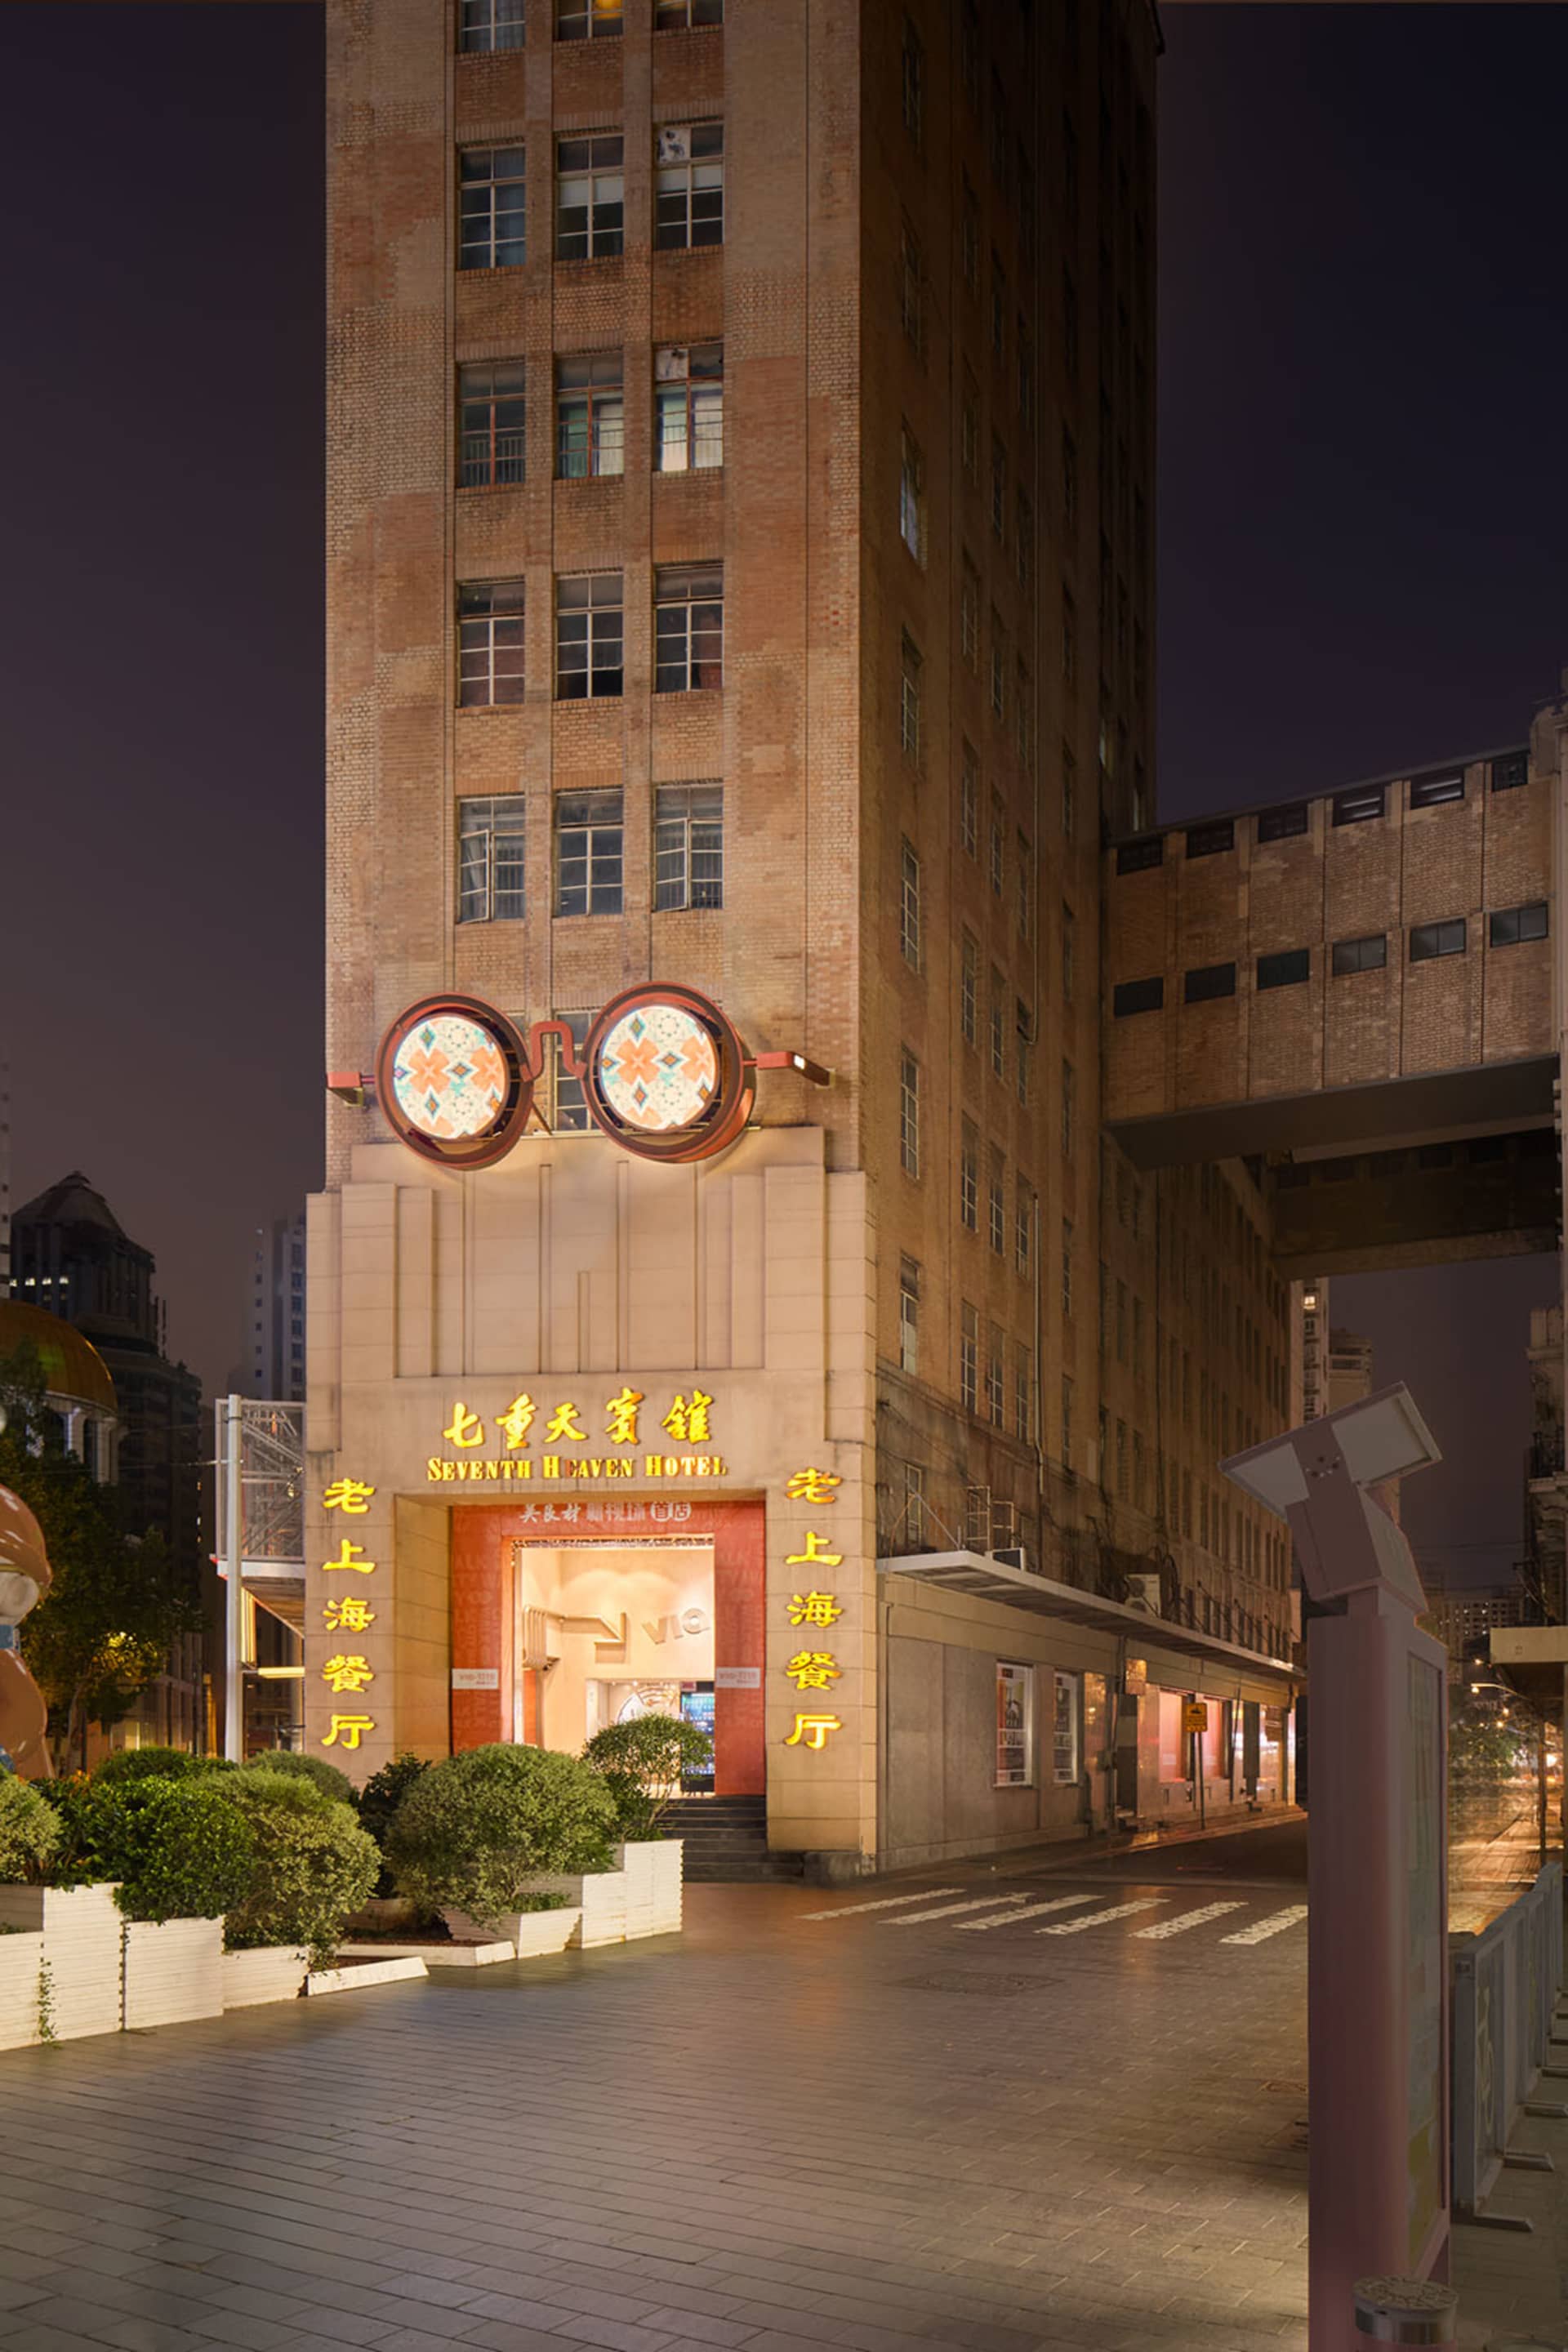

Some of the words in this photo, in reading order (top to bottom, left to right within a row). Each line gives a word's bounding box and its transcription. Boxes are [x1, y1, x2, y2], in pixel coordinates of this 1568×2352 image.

[427, 1456, 531, 1481] SEVENTH
[542, 1454, 634, 1479] HEAVEN
[644, 1454, 727, 1477] HOTEL
[321, 1477, 376, 1750] 老上海餐厅
[785, 1467, 843, 1750] 老上海餐厅
